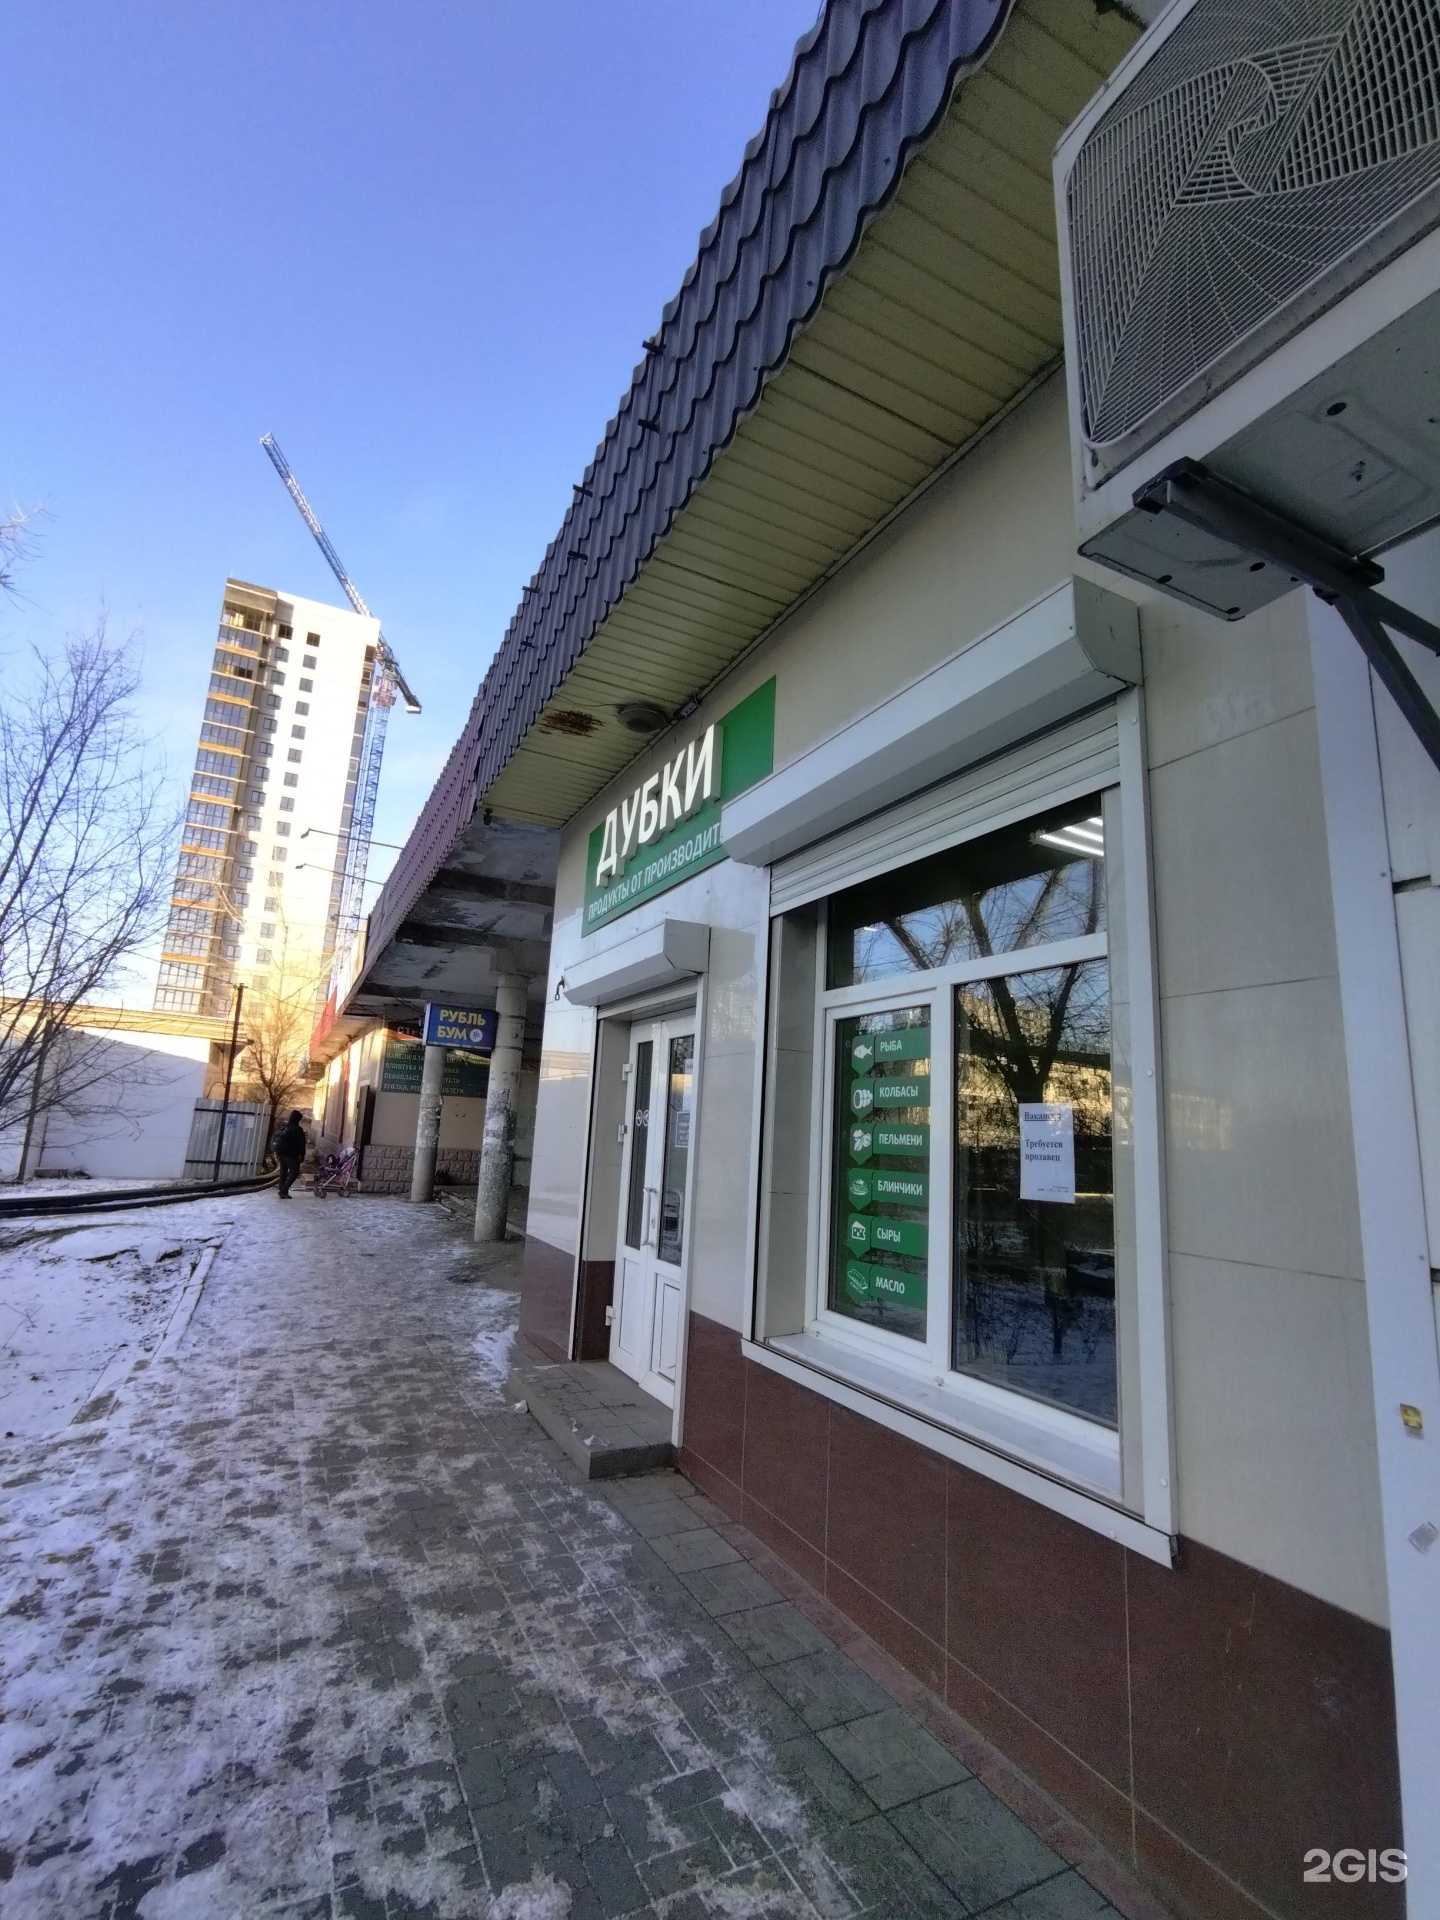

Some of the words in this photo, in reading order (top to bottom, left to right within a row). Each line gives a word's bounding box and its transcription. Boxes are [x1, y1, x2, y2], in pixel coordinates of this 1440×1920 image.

[596, 724, 716, 887] ДУБКИ
[588, 880, 630, 921] ПРОДУКТЫ
[630, 869, 643, 896] ОТ
[644, 822, 721, 886] ПРОИЗВОДИТ
[439, 1009, 487, 1026] РУБЛЬ
[437, 1025, 468, 1041] БУМ
[879, 1040, 903, 1052] РЫБА
[879, 1085, 919, 1098] КОЛБАСЫ
[878, 1132, 923, 1147] ПЕЛЬМЕНИ
[877, 1179, 923, 1196] БЛИНЧИКИ
[876, 1226, 902, 1243] СЫРЫ
[875, 1276, 906, 1295] МАСЛО
